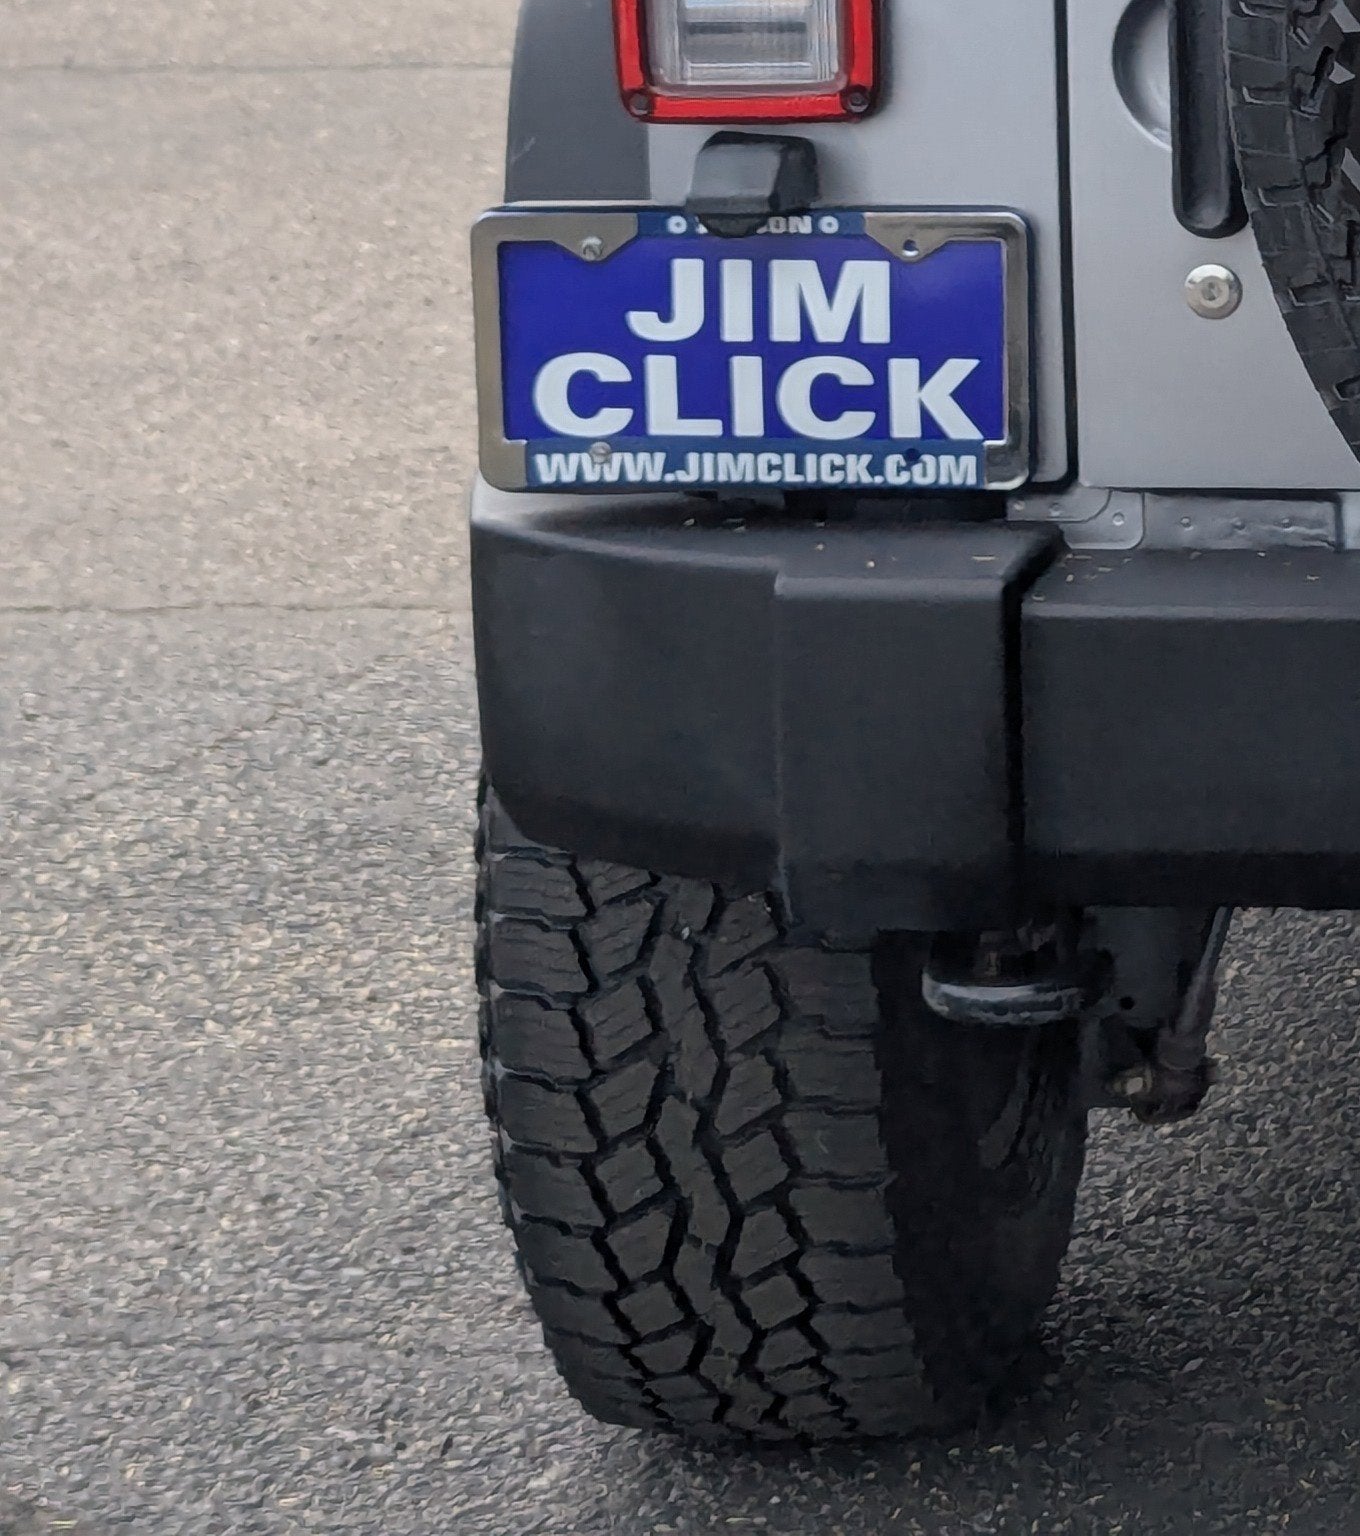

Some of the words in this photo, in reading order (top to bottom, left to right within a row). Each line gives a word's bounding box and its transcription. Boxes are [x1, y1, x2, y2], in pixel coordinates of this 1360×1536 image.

[626, 258, 891, 344] JIM
[533, 352, 984, 440] CLICK
[534, 452, 977, 485] WWW.JIMCLICK.COM
